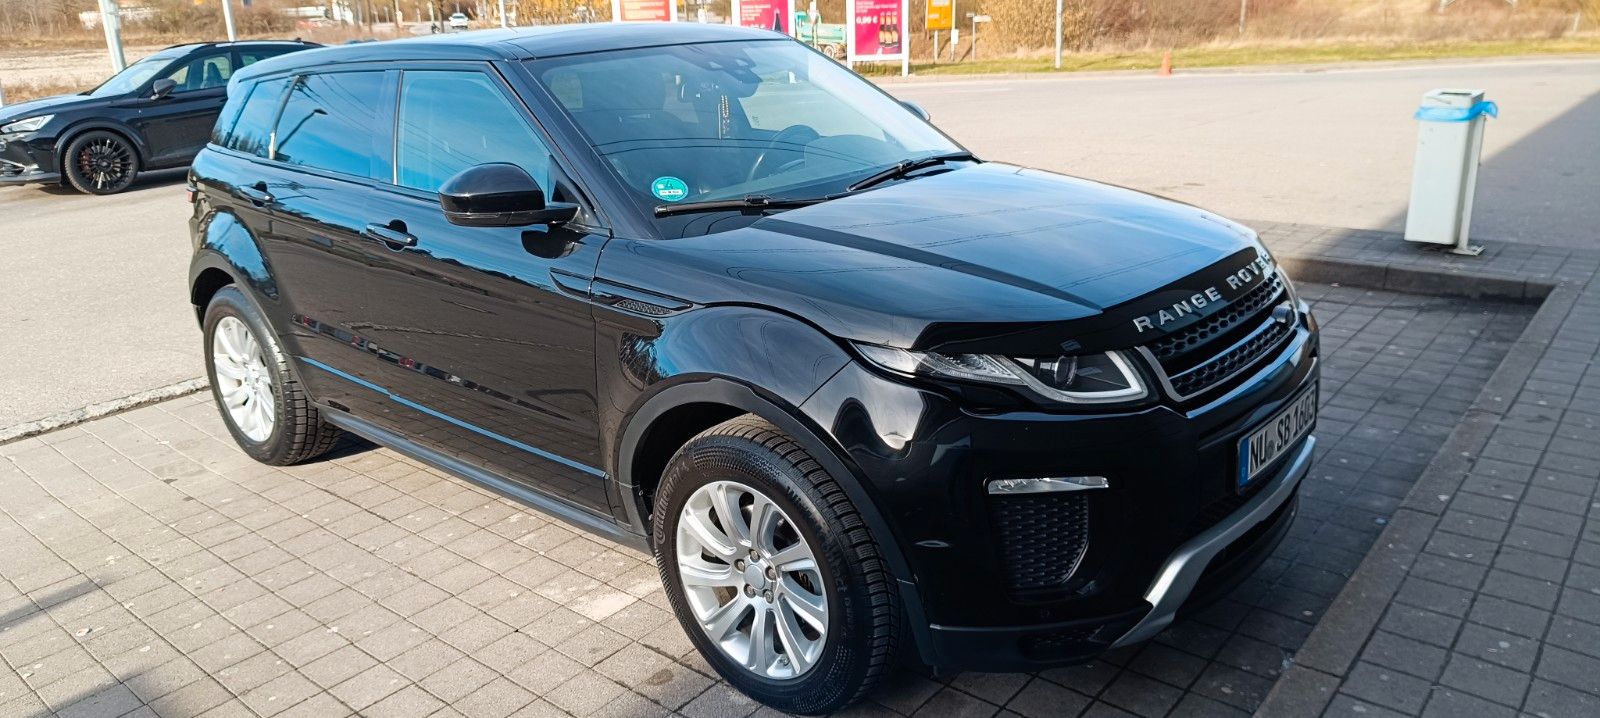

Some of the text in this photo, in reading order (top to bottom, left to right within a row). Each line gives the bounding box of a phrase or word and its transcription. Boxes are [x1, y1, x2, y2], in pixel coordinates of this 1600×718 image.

[1132, 286, 1222, 332] RANGE
[1249, 430, 1269, 475] NU
[1275, 413, 1291, 452] SB
